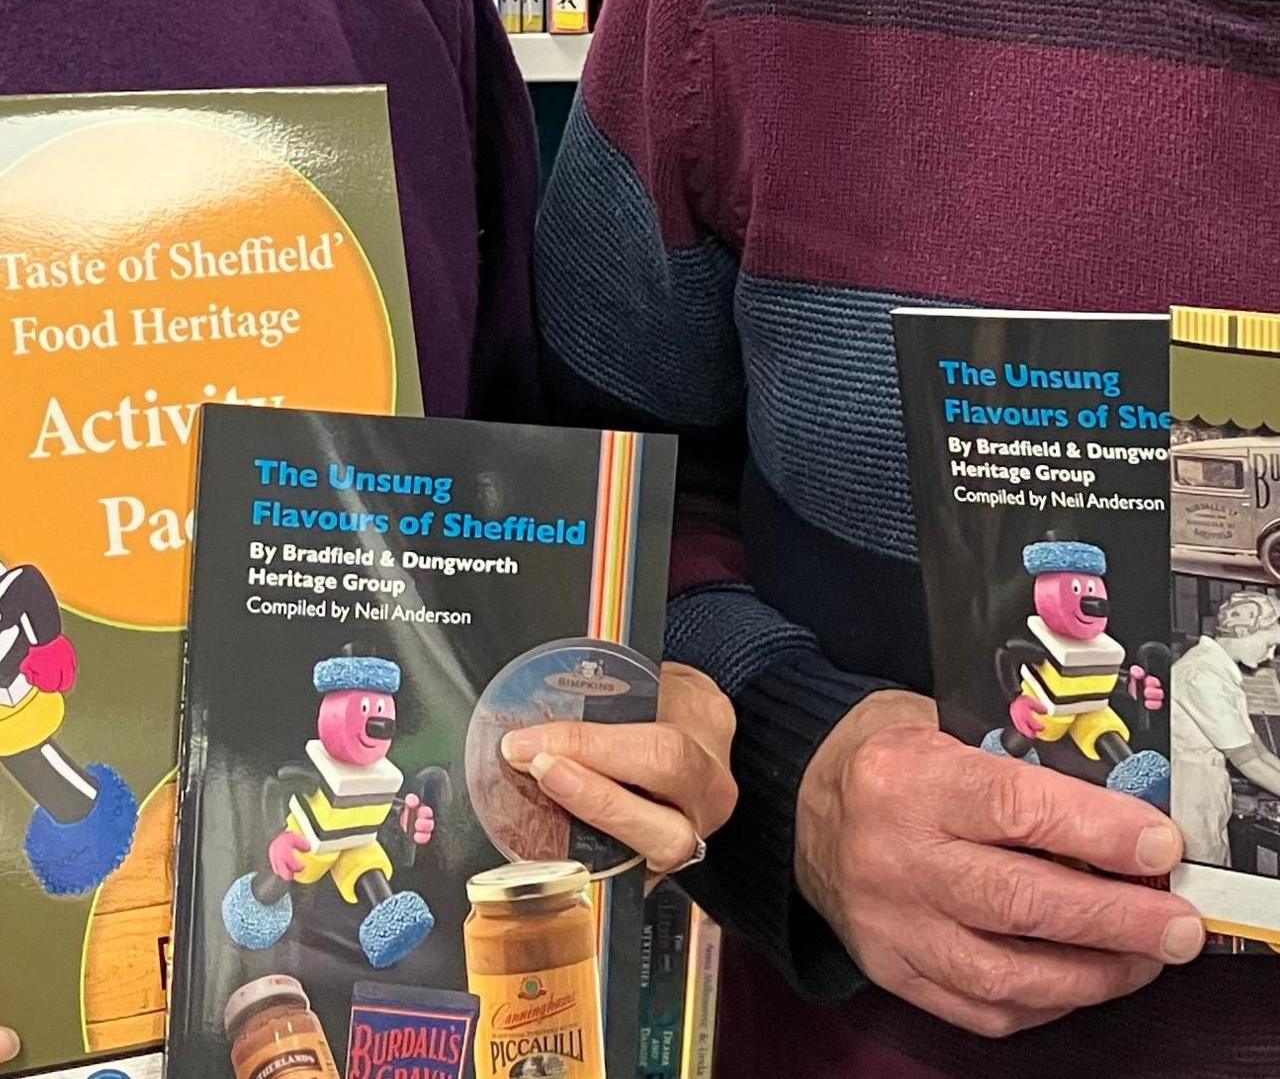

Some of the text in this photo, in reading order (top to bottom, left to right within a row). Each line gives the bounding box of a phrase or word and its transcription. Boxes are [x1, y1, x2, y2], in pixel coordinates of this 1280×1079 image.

[119, 243, 161, 282] of
[12, 303, 301, 355] Food Heritage
[939, 361, 1120, 397] The Unsung
[30, 384, 285, 459] Activ
[944, 398, 1069, 427] Flavours
[1078, 405, 1109, 429] of
[948, 437, 1169, 464] By Bradfield & Dungwo
[255, 459, 452, 504] The Unsung
[951, 461, 1096, 486] Heritage Group
[954, 486, 1165, 511] Compiled by Neil Anderson
[99, 496, 194, 558] Pa
[252, 501, 586, 546] Flavours of Sheffield
[250, 542, 518, 574] By Bradfield & Dungworth
[248, 568, 406, 597] Heritage Group
[246, 596, 471, 624] Compiled by Neil Anderson
[350, 1024, 461, 1070] BURDALL'S
[490, 1029, 584, 1075] PICCALILLI
